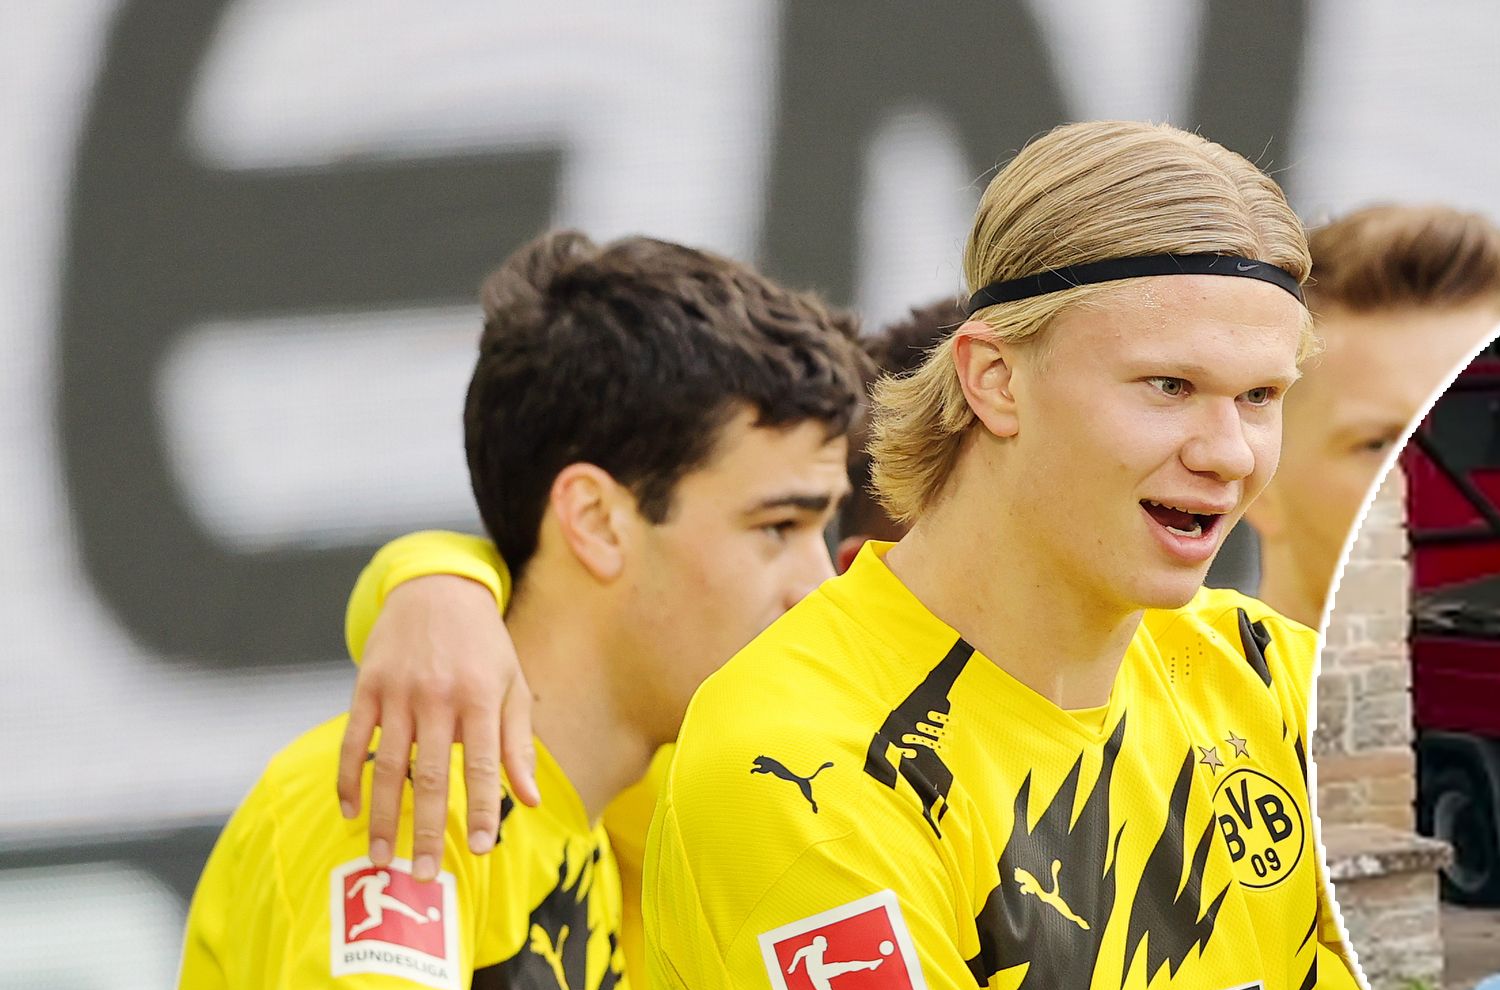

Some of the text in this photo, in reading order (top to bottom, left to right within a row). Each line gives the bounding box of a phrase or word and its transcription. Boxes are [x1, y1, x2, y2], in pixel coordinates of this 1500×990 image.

[1218, 777, 1293, 863] BVB
[1250, 847, 1281, 877] 09
[344, 950, 448, 979] BUNDESLIGA
